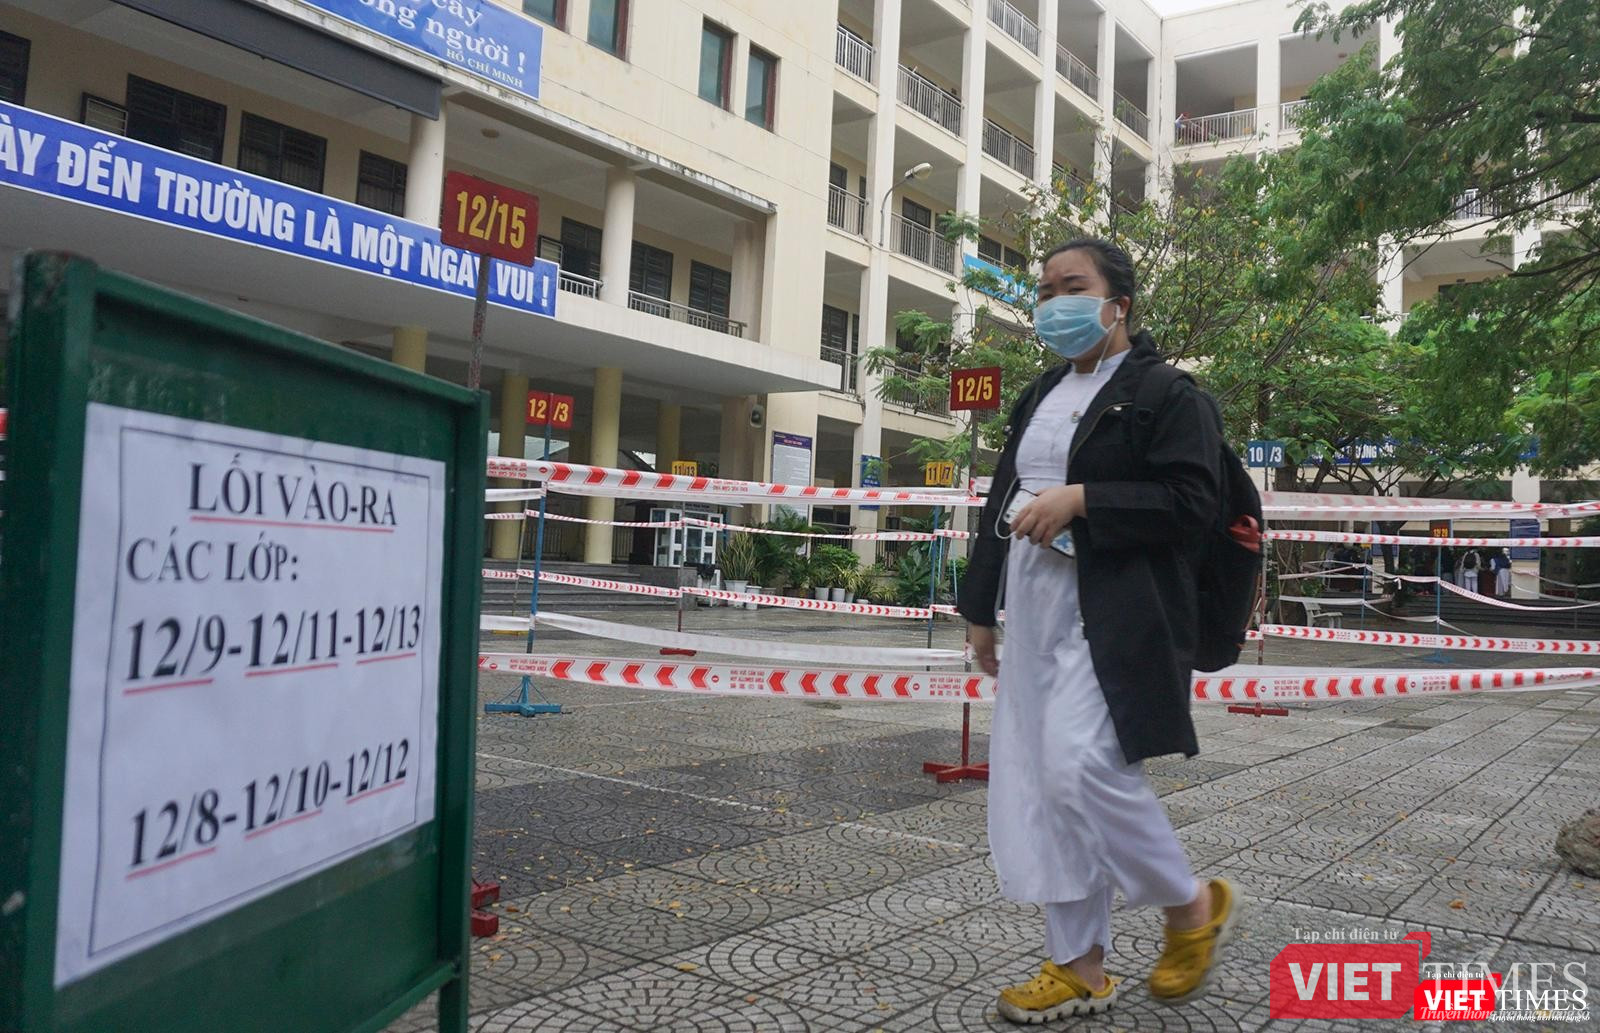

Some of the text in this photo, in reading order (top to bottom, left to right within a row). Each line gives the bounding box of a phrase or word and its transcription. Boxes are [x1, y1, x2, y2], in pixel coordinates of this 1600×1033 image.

[426, 17, 509, 67] người
[467, 58, 489, 74] CHÍ
[491, 68, 523, 88] MINH
[57, 140, 143, 203] ĐẾN
[154, 167, 296, 243] TRƯỜNG
[304, 206, 342, 255] LÀ
[351, 224, 414, 275] MỘT
[496, 262, 534, 304] VUI
[456, 191, 527, 249] 12/15
[957, 375, 993, 402] 12/5
[188, 453, 397, 527] LỐI VÀO-RA
[126, 527, 299, 582] CÁC LỚP:
